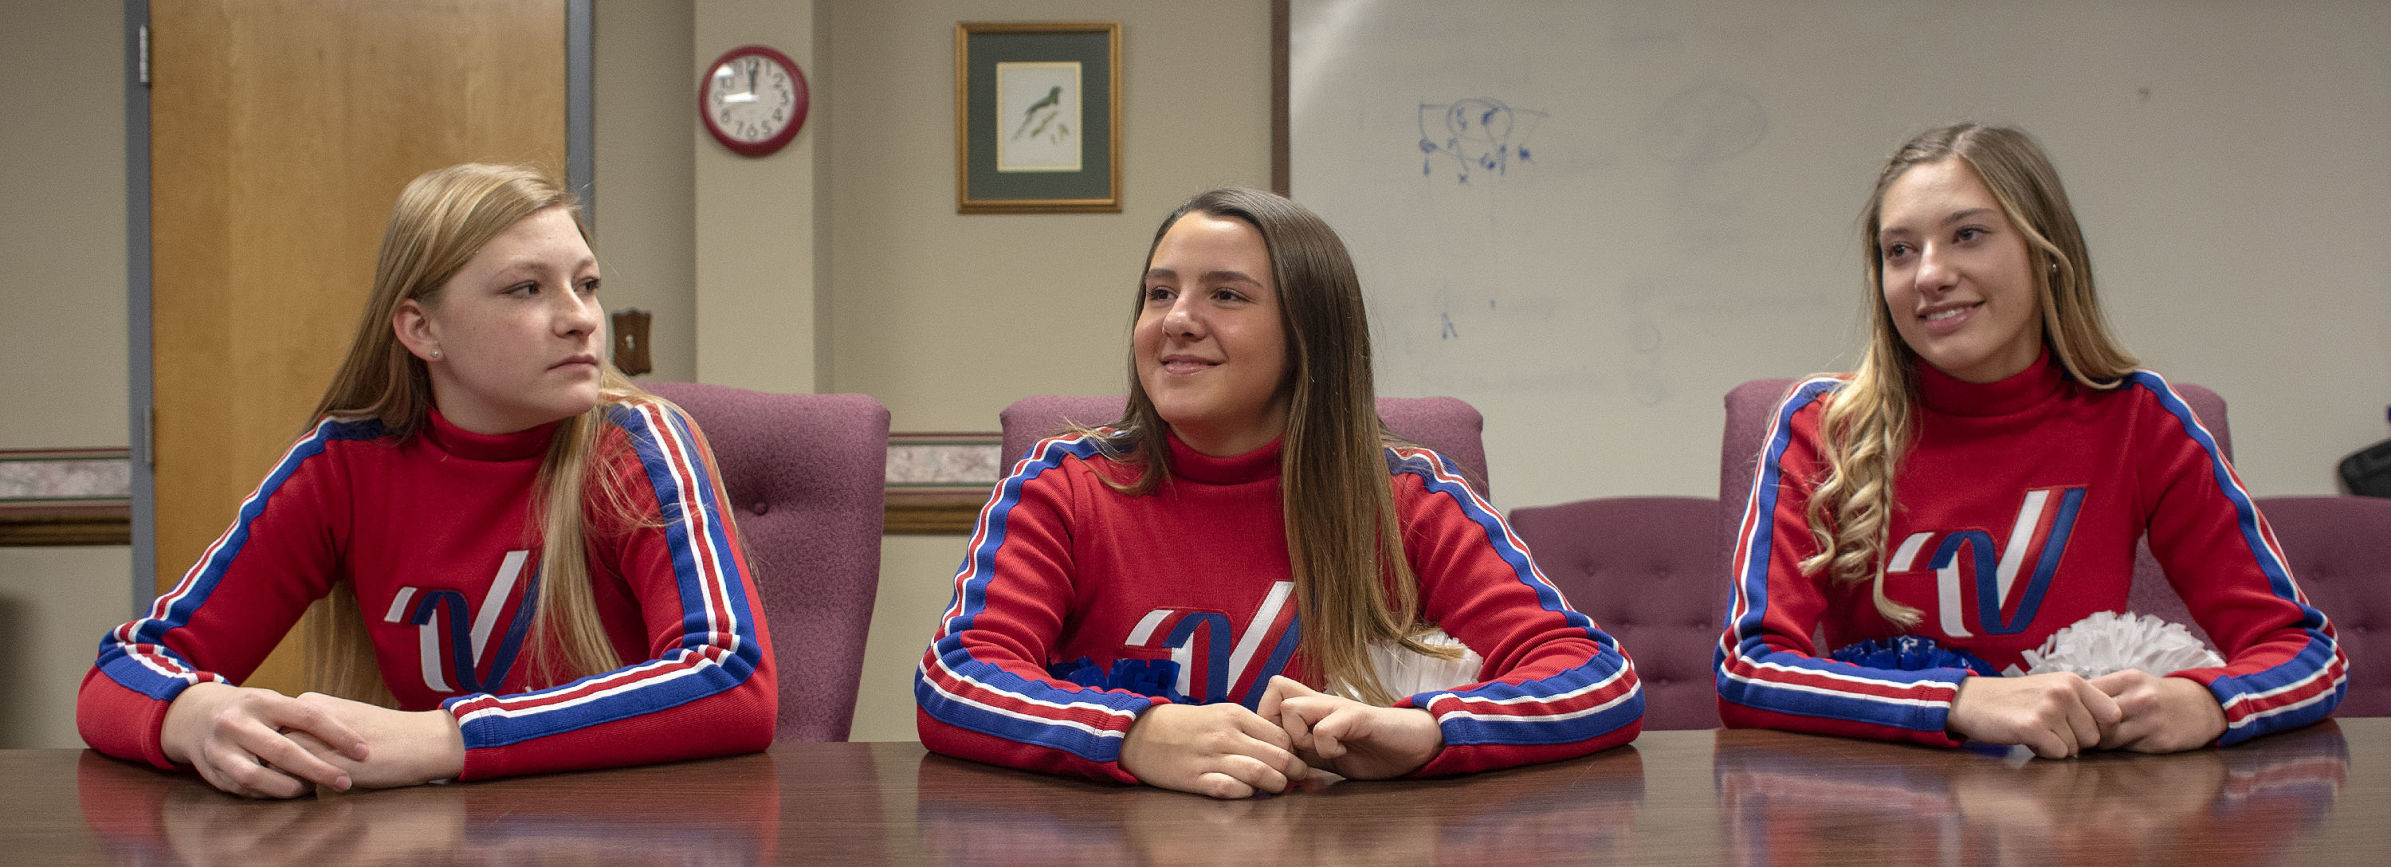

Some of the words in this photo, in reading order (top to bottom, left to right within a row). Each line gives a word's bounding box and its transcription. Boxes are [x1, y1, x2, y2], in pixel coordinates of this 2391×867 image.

[773, 72, 784, 90] 2
[720, 107, 731, 125] 8
[772, 107, 783, 122] 4
[736, 120, 744, 136] 7
[745, 122, 758, 137] 6
[760, 120, 772, 136] 5
